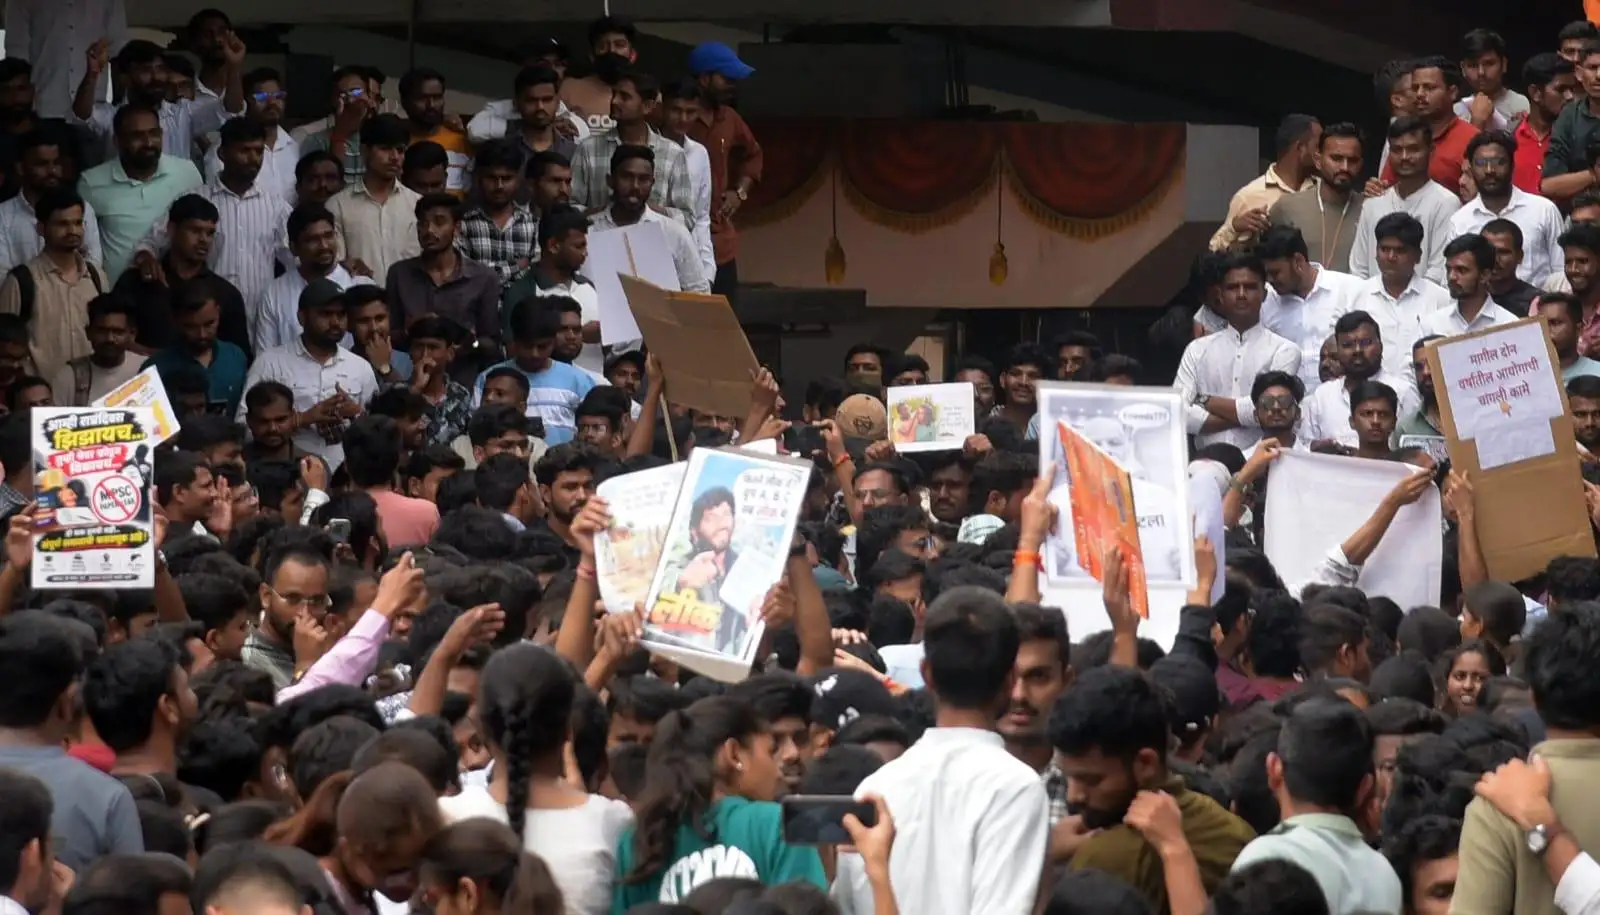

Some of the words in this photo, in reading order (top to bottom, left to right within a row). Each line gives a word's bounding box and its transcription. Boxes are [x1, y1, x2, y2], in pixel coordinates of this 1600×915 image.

[1469, 347, 1499, 365] मागील
[1500, 342, 1518, 358] दोन
[1496, 356, 1540, 380] आयोगाची
[1510, 380, 1531, 398] कामे
